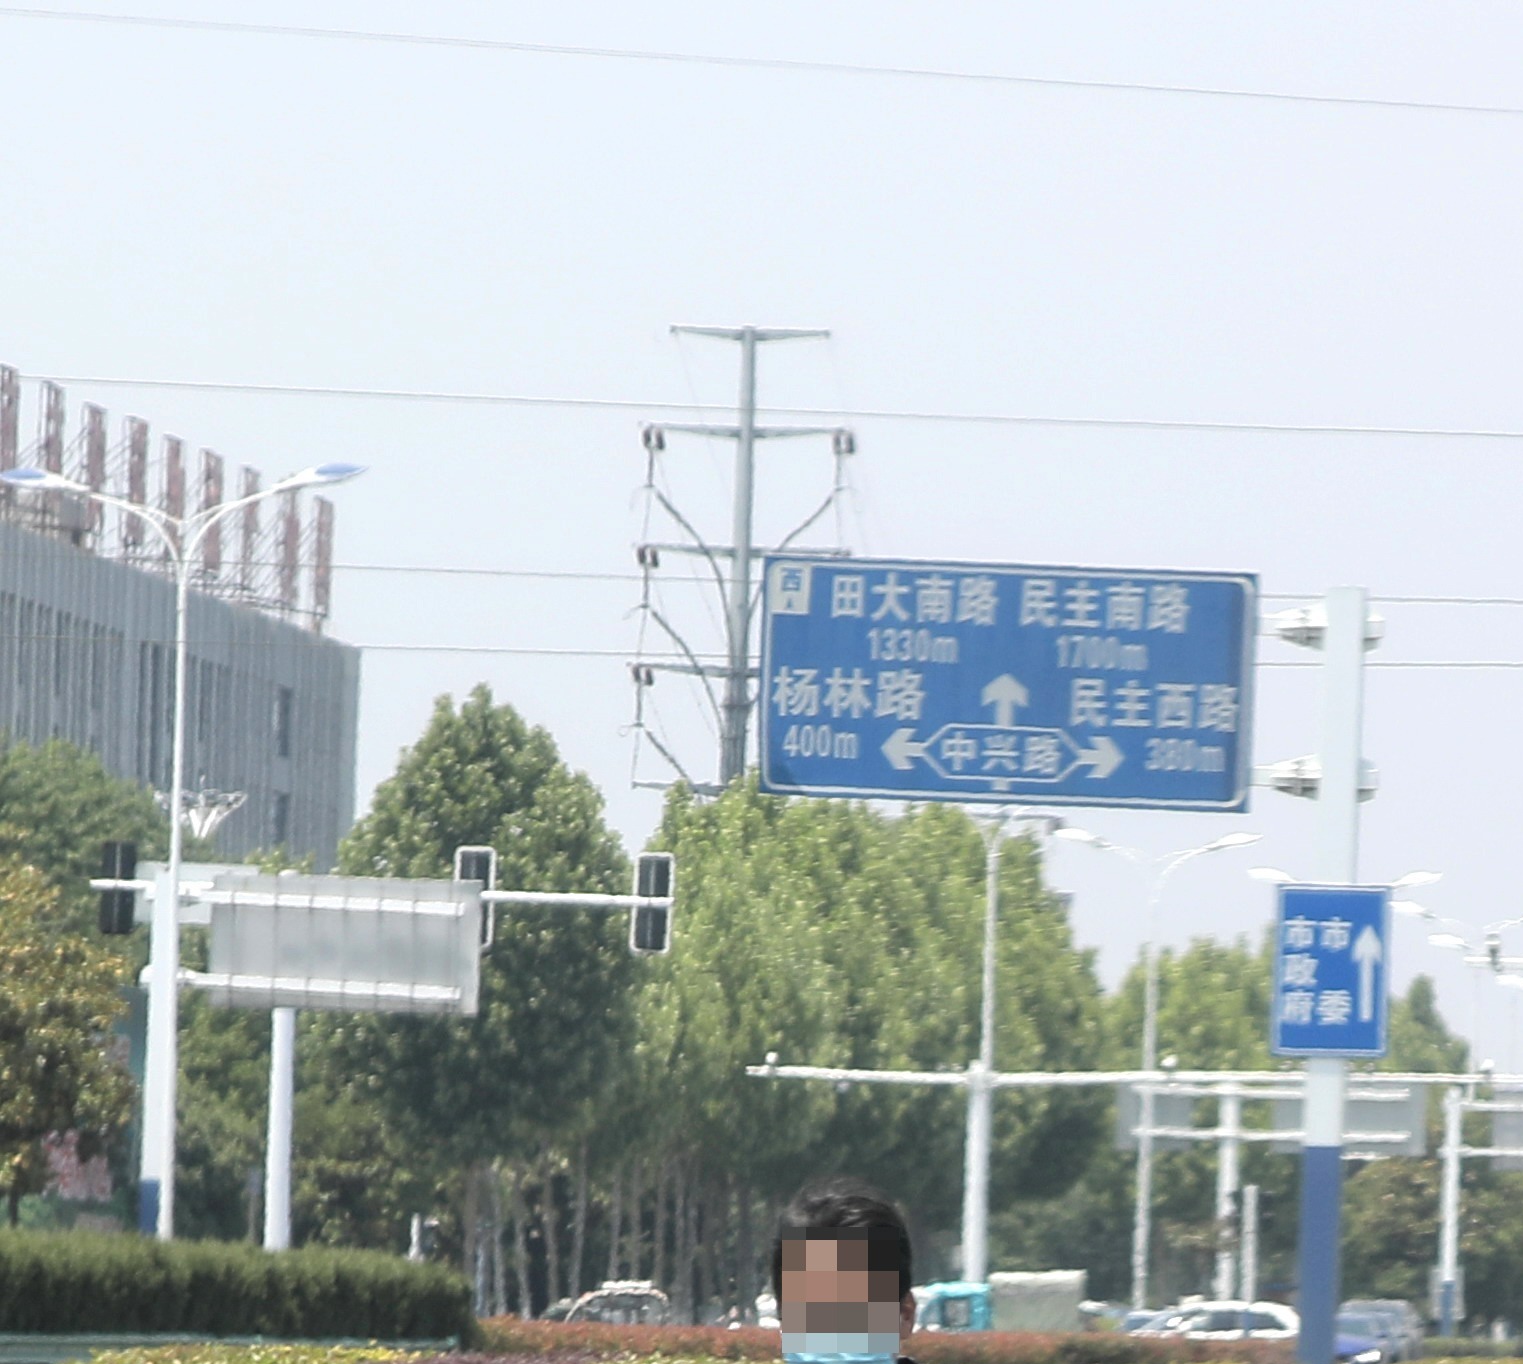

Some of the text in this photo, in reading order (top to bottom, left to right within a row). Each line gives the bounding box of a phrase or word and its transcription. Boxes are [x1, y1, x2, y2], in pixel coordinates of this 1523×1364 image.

[831, 571, 1192, 634] 田大南路 民主南路
[866, 626, 960, 664] 1330m
[772, 665, 927, 721] 杨林路
[1070, 677, 1240, 733] 民主西路
[782, 724, 859, 760] 400m
[941, 731, 1063, 775] 中兴路
[1279, 915, 1319, 1025] 市政府
[1317, 916, 1352, 1025] 市委
